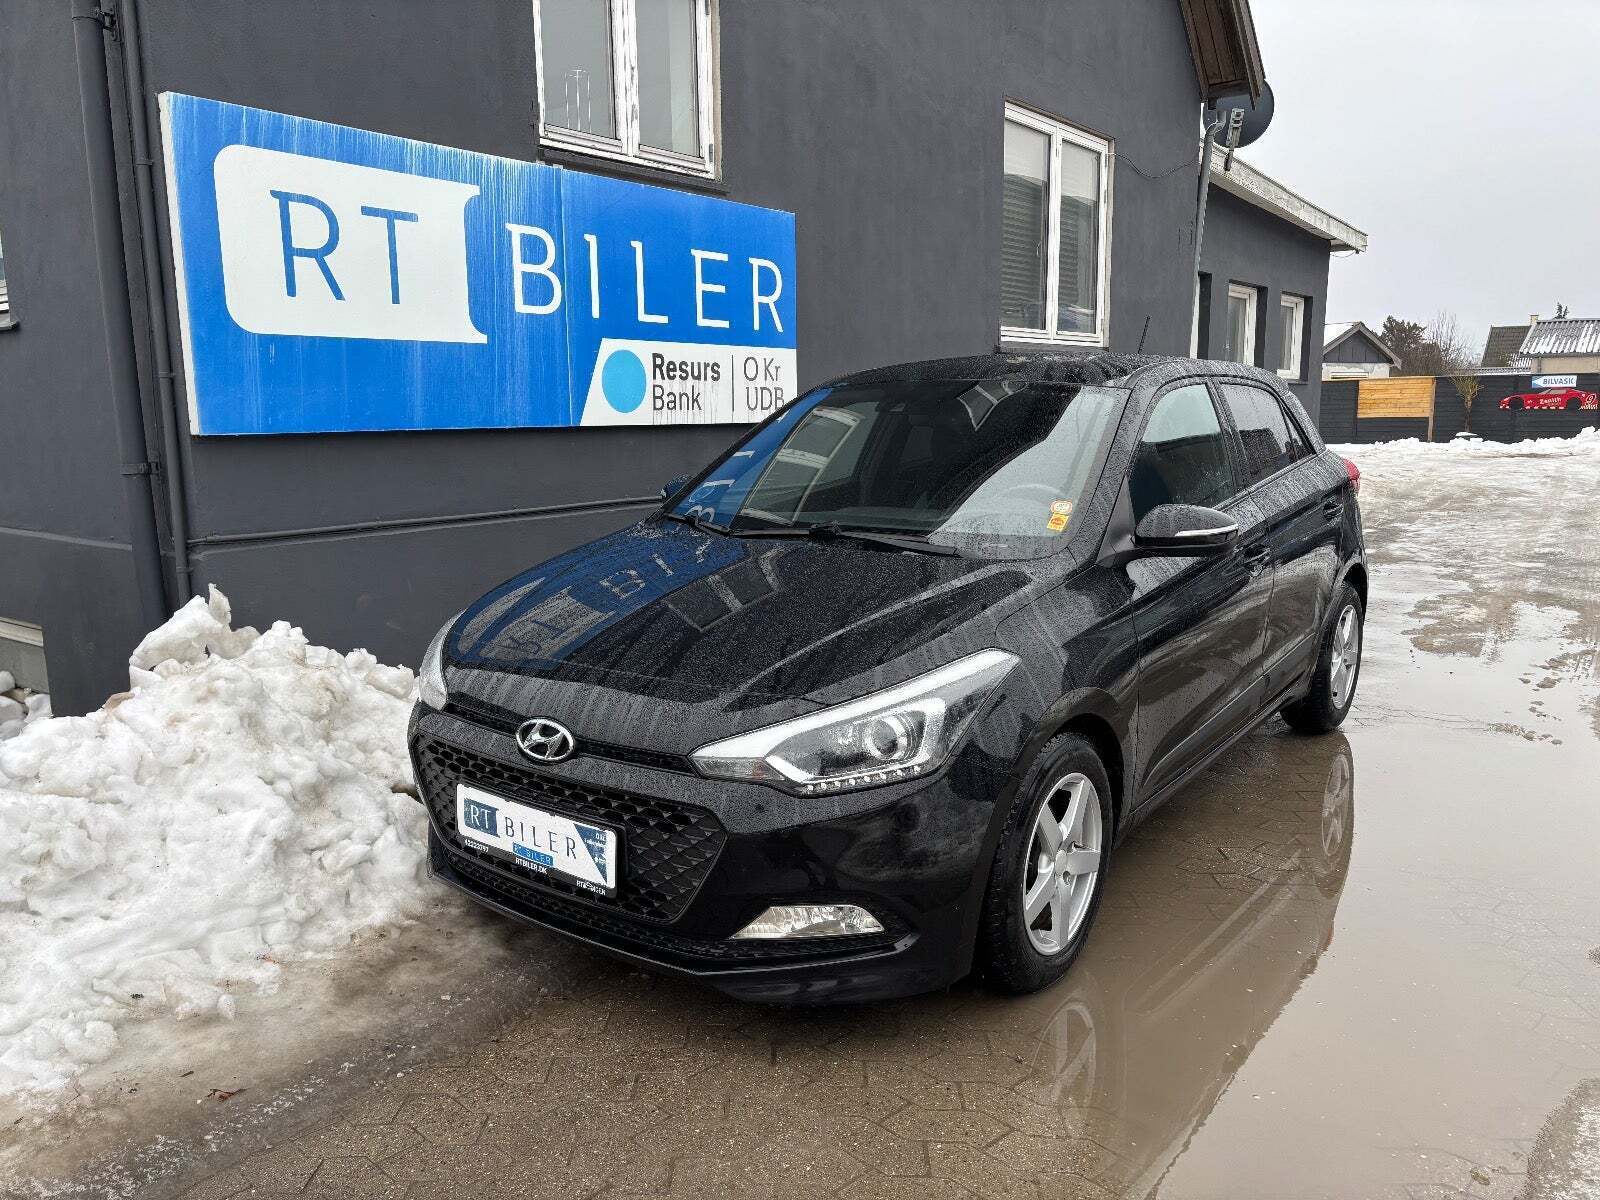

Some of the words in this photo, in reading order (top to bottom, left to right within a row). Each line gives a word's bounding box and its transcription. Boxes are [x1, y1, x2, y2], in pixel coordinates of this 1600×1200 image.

[269, 189, 419, 305] RT
[506, 223, 784, 333] BILER
[652, 353, 721, 381] Resurs
[764, 357, 781, 382] Kr
[653, 384, 703, 411] Bank
[746, 386, 785, 411] UDB
[470, 805, 492, 829] RT
[504, 816, 577, 860] BILER
